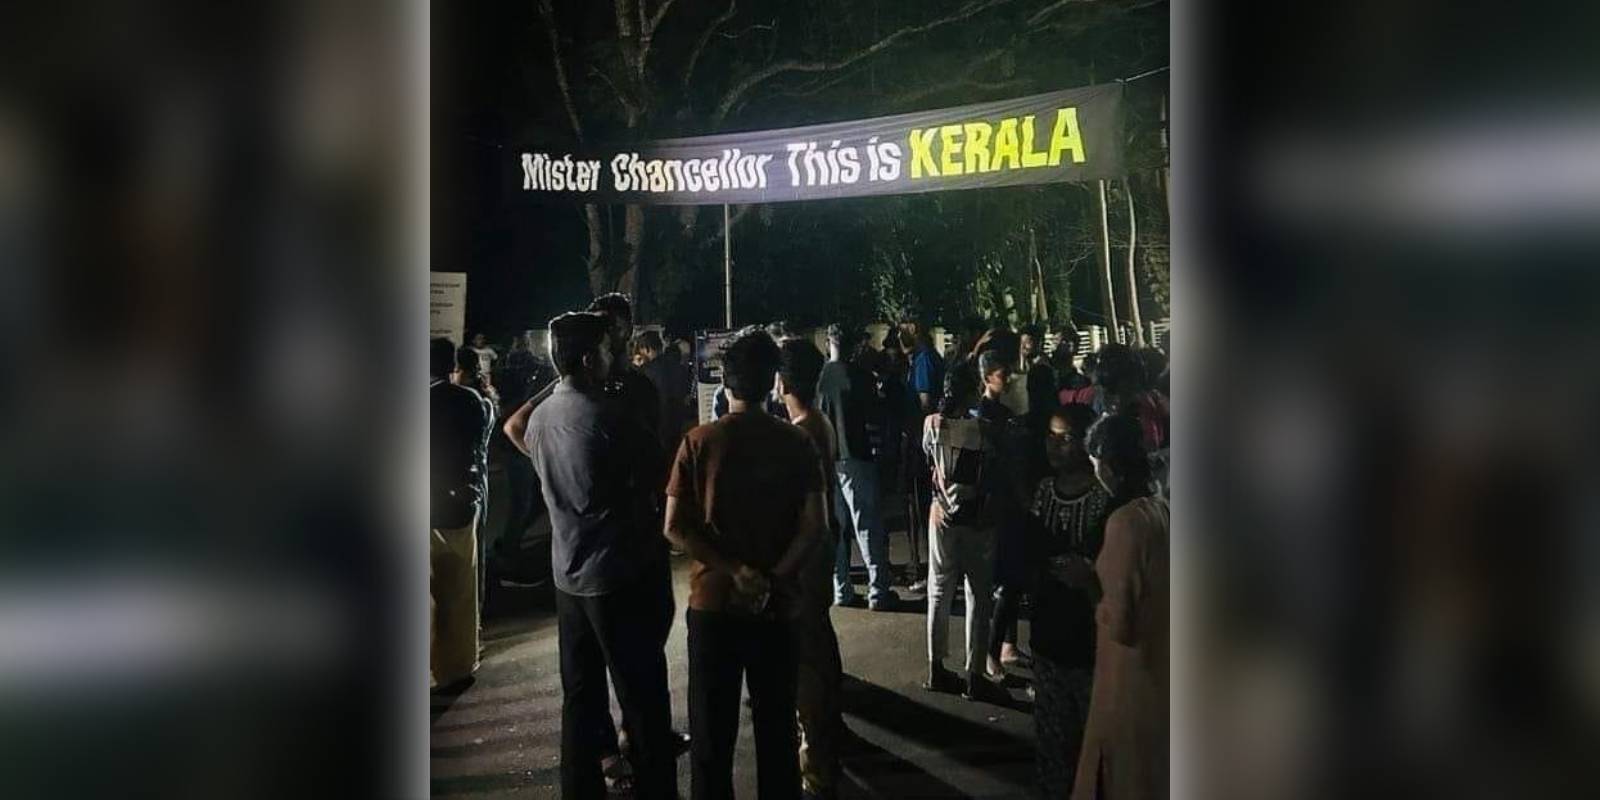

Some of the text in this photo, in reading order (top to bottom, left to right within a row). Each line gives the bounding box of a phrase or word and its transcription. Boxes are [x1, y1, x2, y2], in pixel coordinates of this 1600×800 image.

[521, 107, 1085, 193] Mister Chancellor This is KERALA
